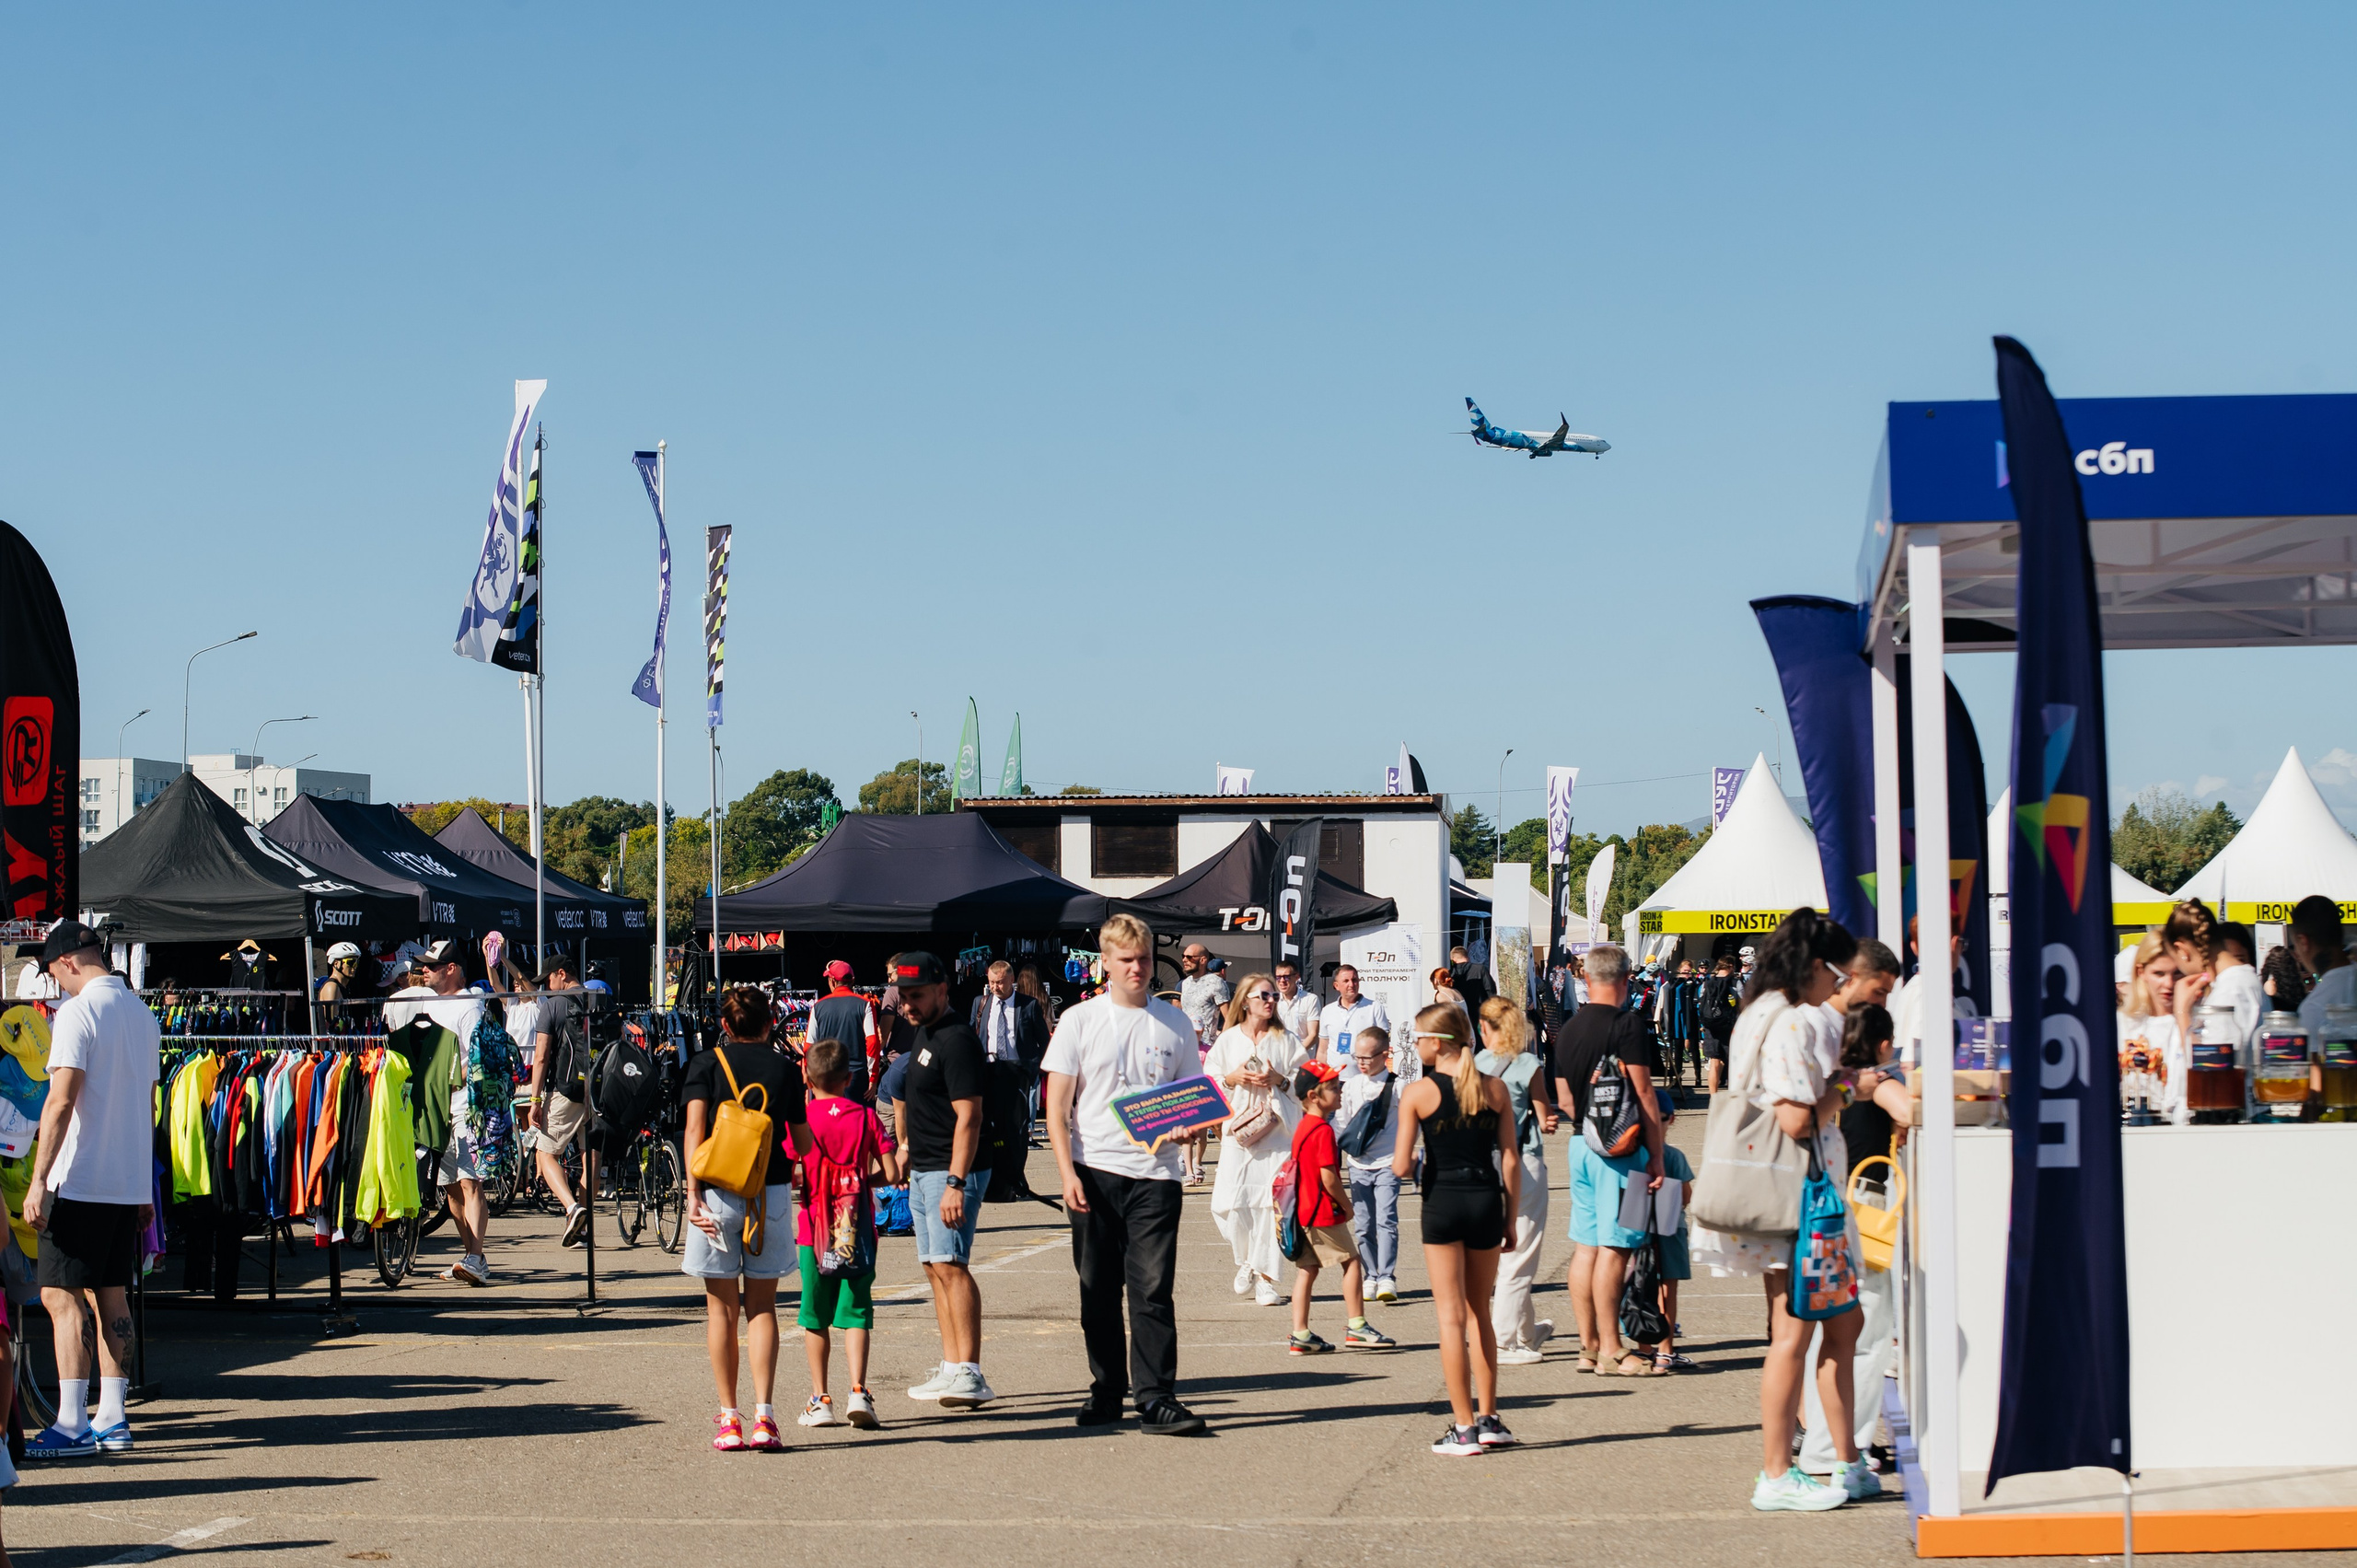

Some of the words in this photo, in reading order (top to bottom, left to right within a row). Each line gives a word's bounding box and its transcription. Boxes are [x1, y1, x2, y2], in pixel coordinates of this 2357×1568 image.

[2074, 441, 2154, 475] сбп
[52, 765, 66, 817] ШАГ
[49, 826, 65, 918] АЖДЫЙ
[324, 910, 363, 926] SCOTT
[555, 907, 584, 928] veter.cc
[2257, 903, 2294, 920] IRON
[2339, 903, 2357, 920] SH
[1640, 921, 1663, 932] STAR
[2037, 943, 2090, 1167] сбп
[1123, 1103, 1141, 1113] ЭТО
[1140, 1098, 1163, 1108] БЫЛА
[1135, 1105, 1162, 1117] ТЕПЕРЬ
[1144, 1112, 1160, 1121] ЧТО
[822, 1259, 838, 1270] KIDS
[29, 1448, 61, 1457] crocs
